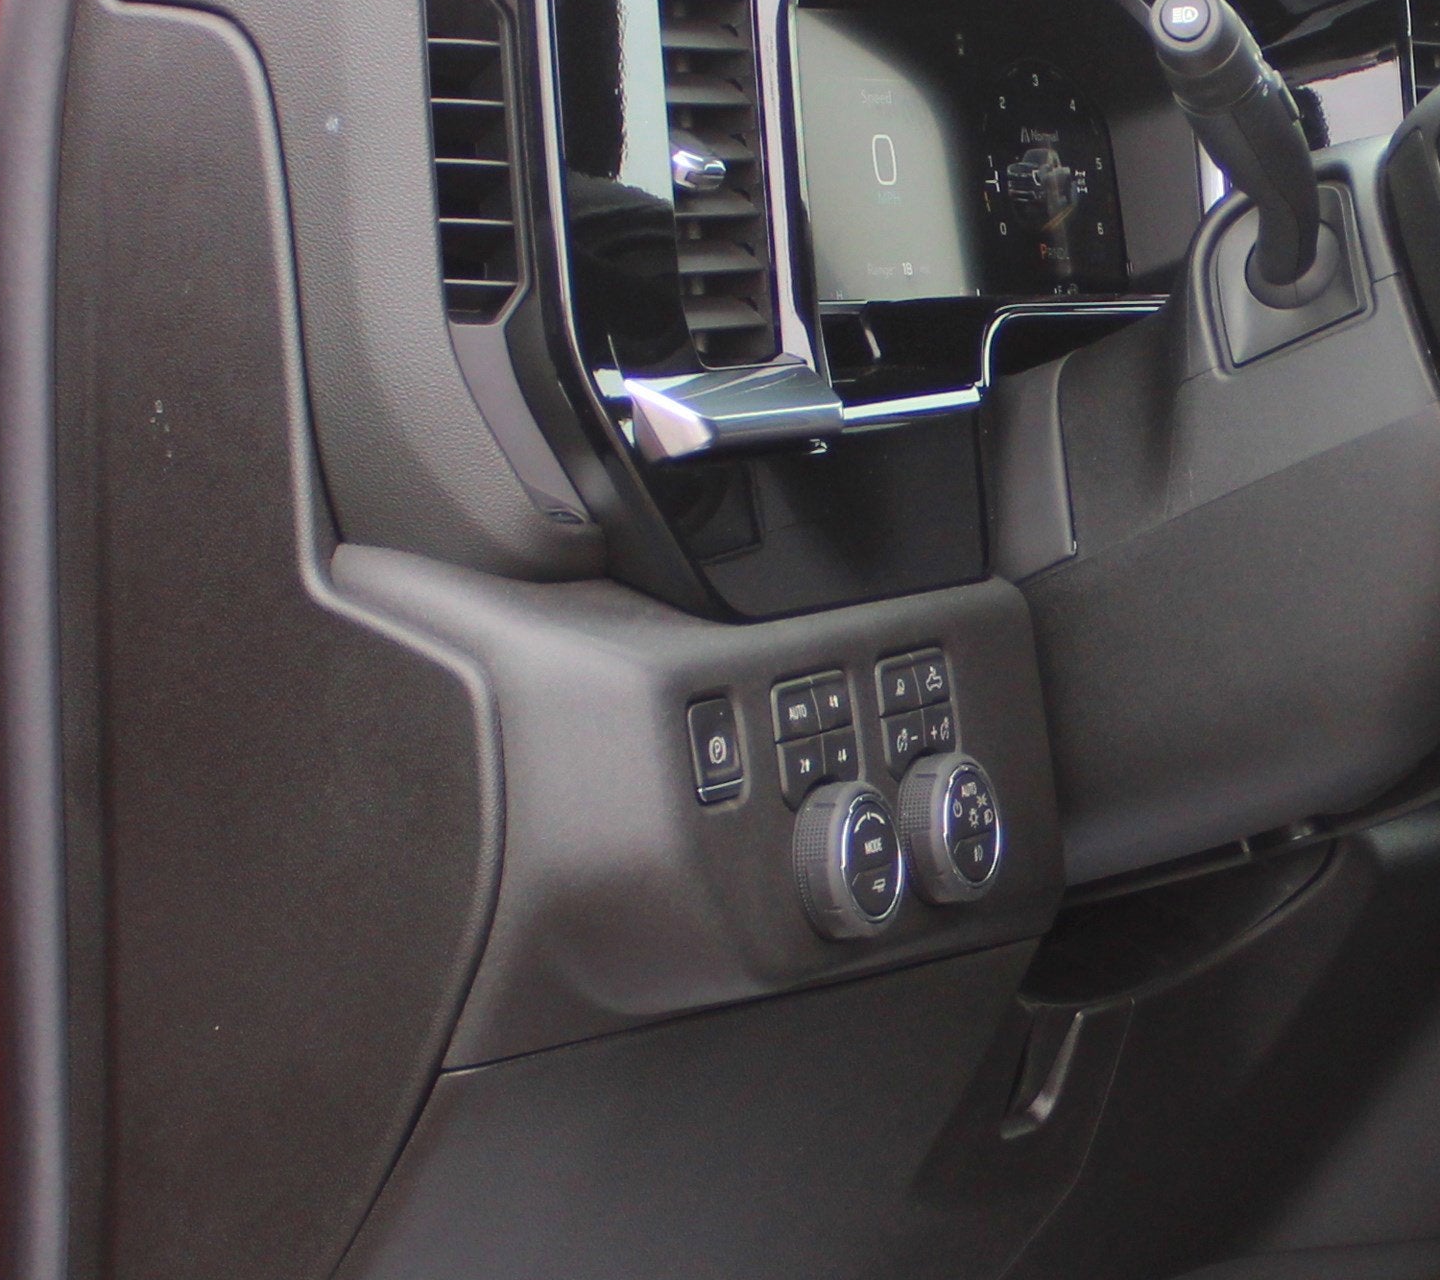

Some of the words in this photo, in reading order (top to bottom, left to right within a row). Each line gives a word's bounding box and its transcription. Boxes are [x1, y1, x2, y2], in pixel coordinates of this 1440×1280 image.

[1032, 73, 1039, 87] 3
[860, 89, 893, 107] Speed
[999, 96, 1006, 109] 2
[1069, 99, 1076, 111] 4
[1031, 128, 1059, 141] Normal
[872, 134, 897, 186] 0
[1095, 157, 1103, 171] 5
[1000, 222, 1007, 236] 0
[1096, 222, 1104, 235] 6
[789, 704, 807, 720] AUTO
